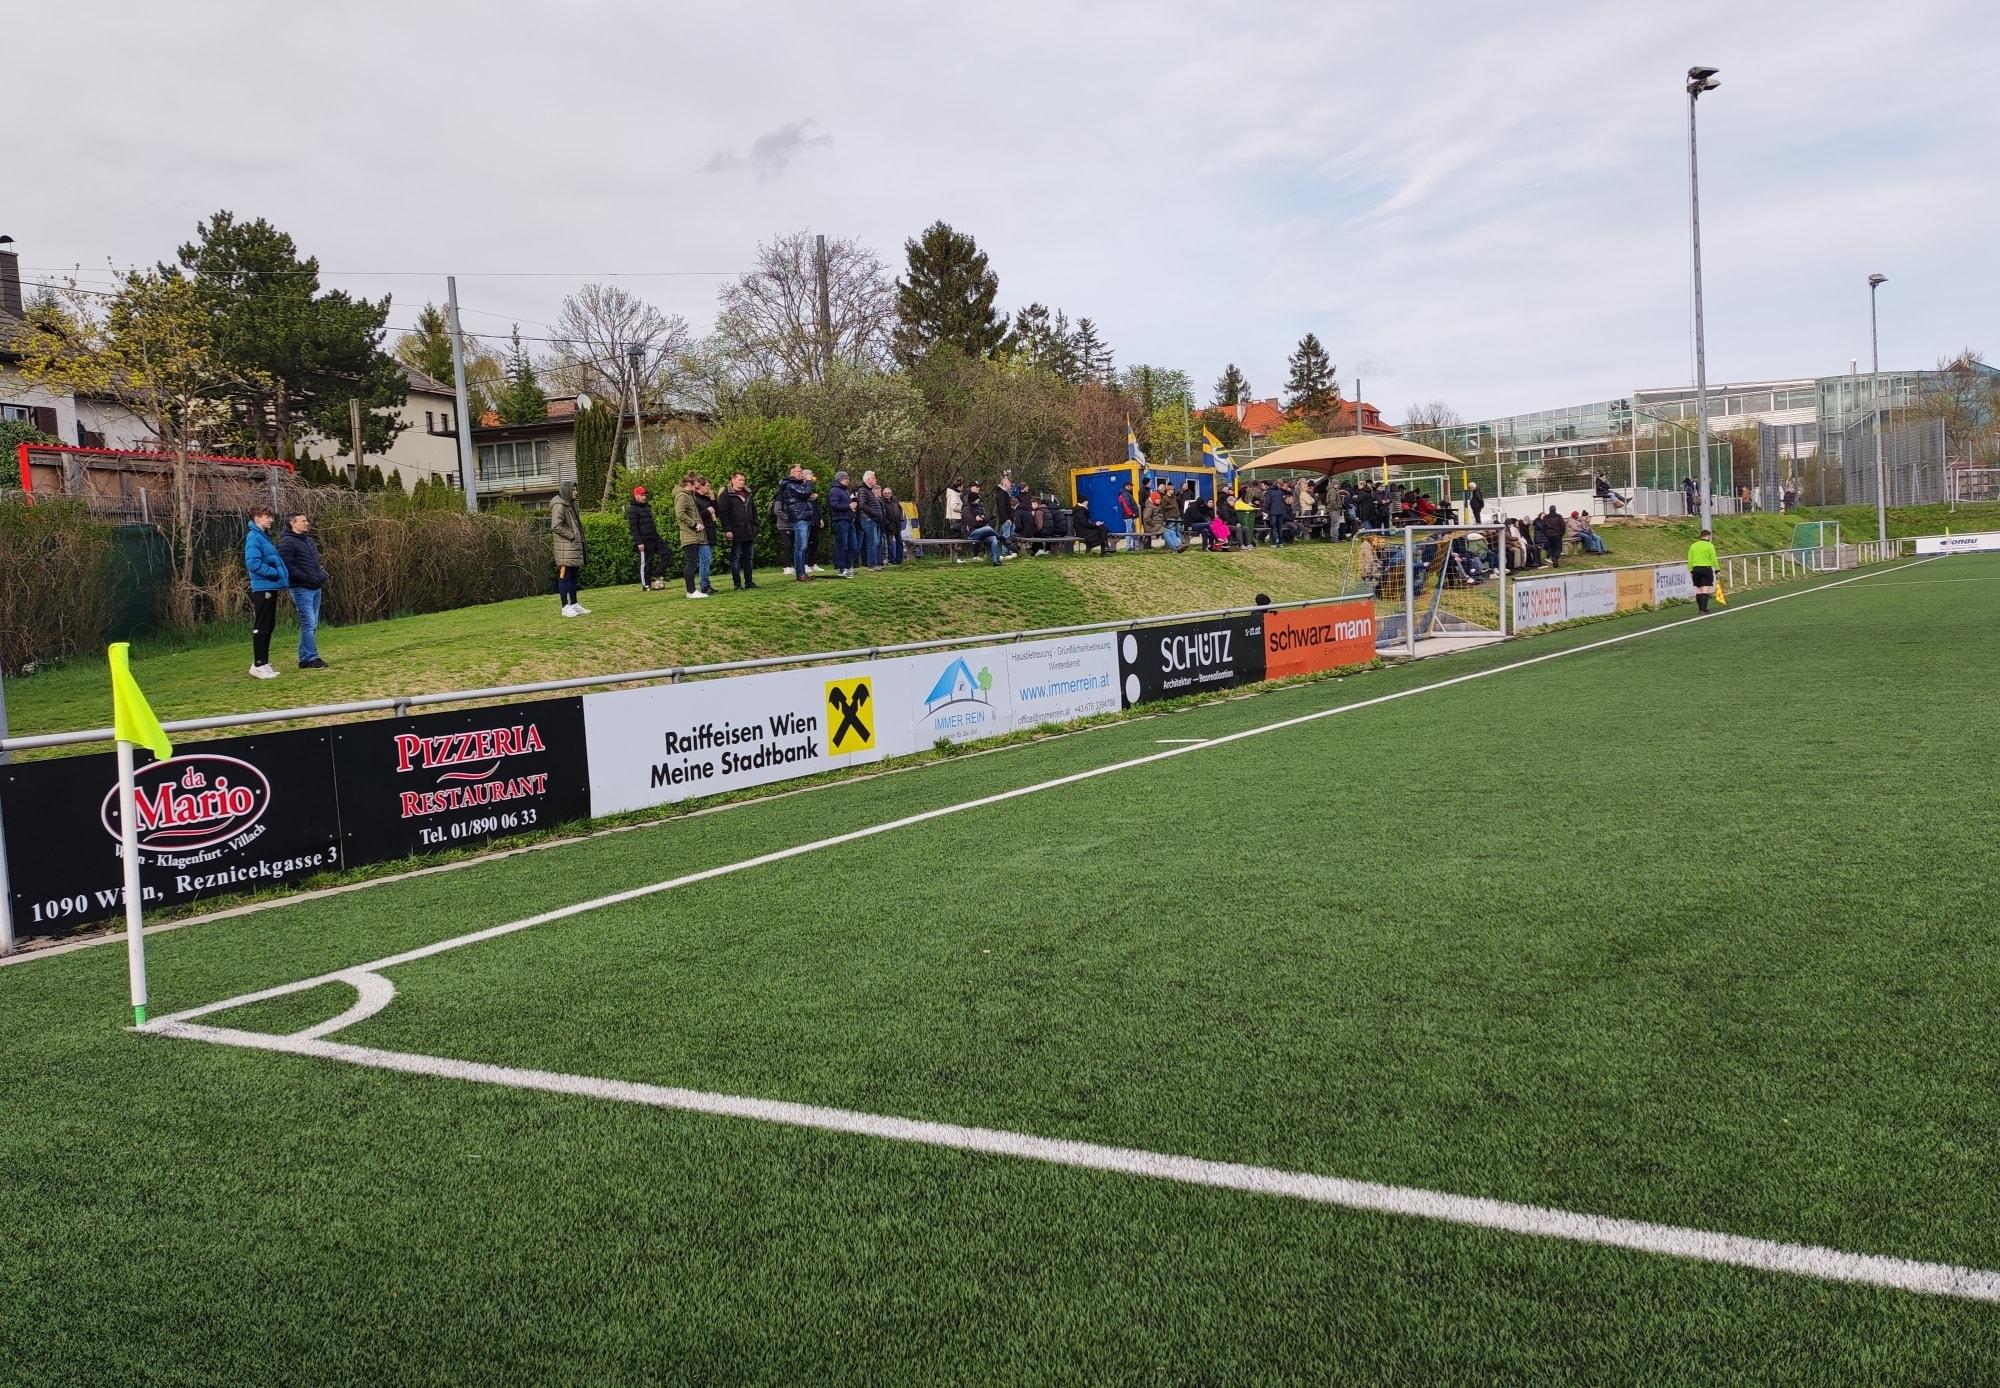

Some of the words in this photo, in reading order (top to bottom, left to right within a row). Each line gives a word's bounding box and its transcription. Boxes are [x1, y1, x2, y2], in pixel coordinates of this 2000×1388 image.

[1160, 629, 1233, 673] SCHÜTZ
[1019, 672, 1110, 701] www.immerrein.at
[665, 722, 764, 755] Raiffeisen
[769, 712, 818, 737] Wien
[934, 714, 963, 730] IMMER
[965, 710, 985, 725] REIN
[394, 723, 546, 773] PIZZERIA
[650, 758, 714, 789] Meine
[721, 736, 819, 775] Stadtbank
[182, 766, 206, 789] da
[399, 773, 548, 818] RESTAURANT
[133, 776, 254, 832] Mario
[156, 849, 222, 870] Klagenfurt
[228, 823, 267, 851] Villach
[419, 826, 448, 845] Tel.
[451, 815, 498, 839] 01/890
[501, 812, 518, 829] 06
[521, 808, 537, 826] 33
[31, 894, 89, 923] 1090
[94, 885, 164, 909] Win,
[175, 852, 323, 895] Reznicekgasse
[327, 846, 338, 863] 3
